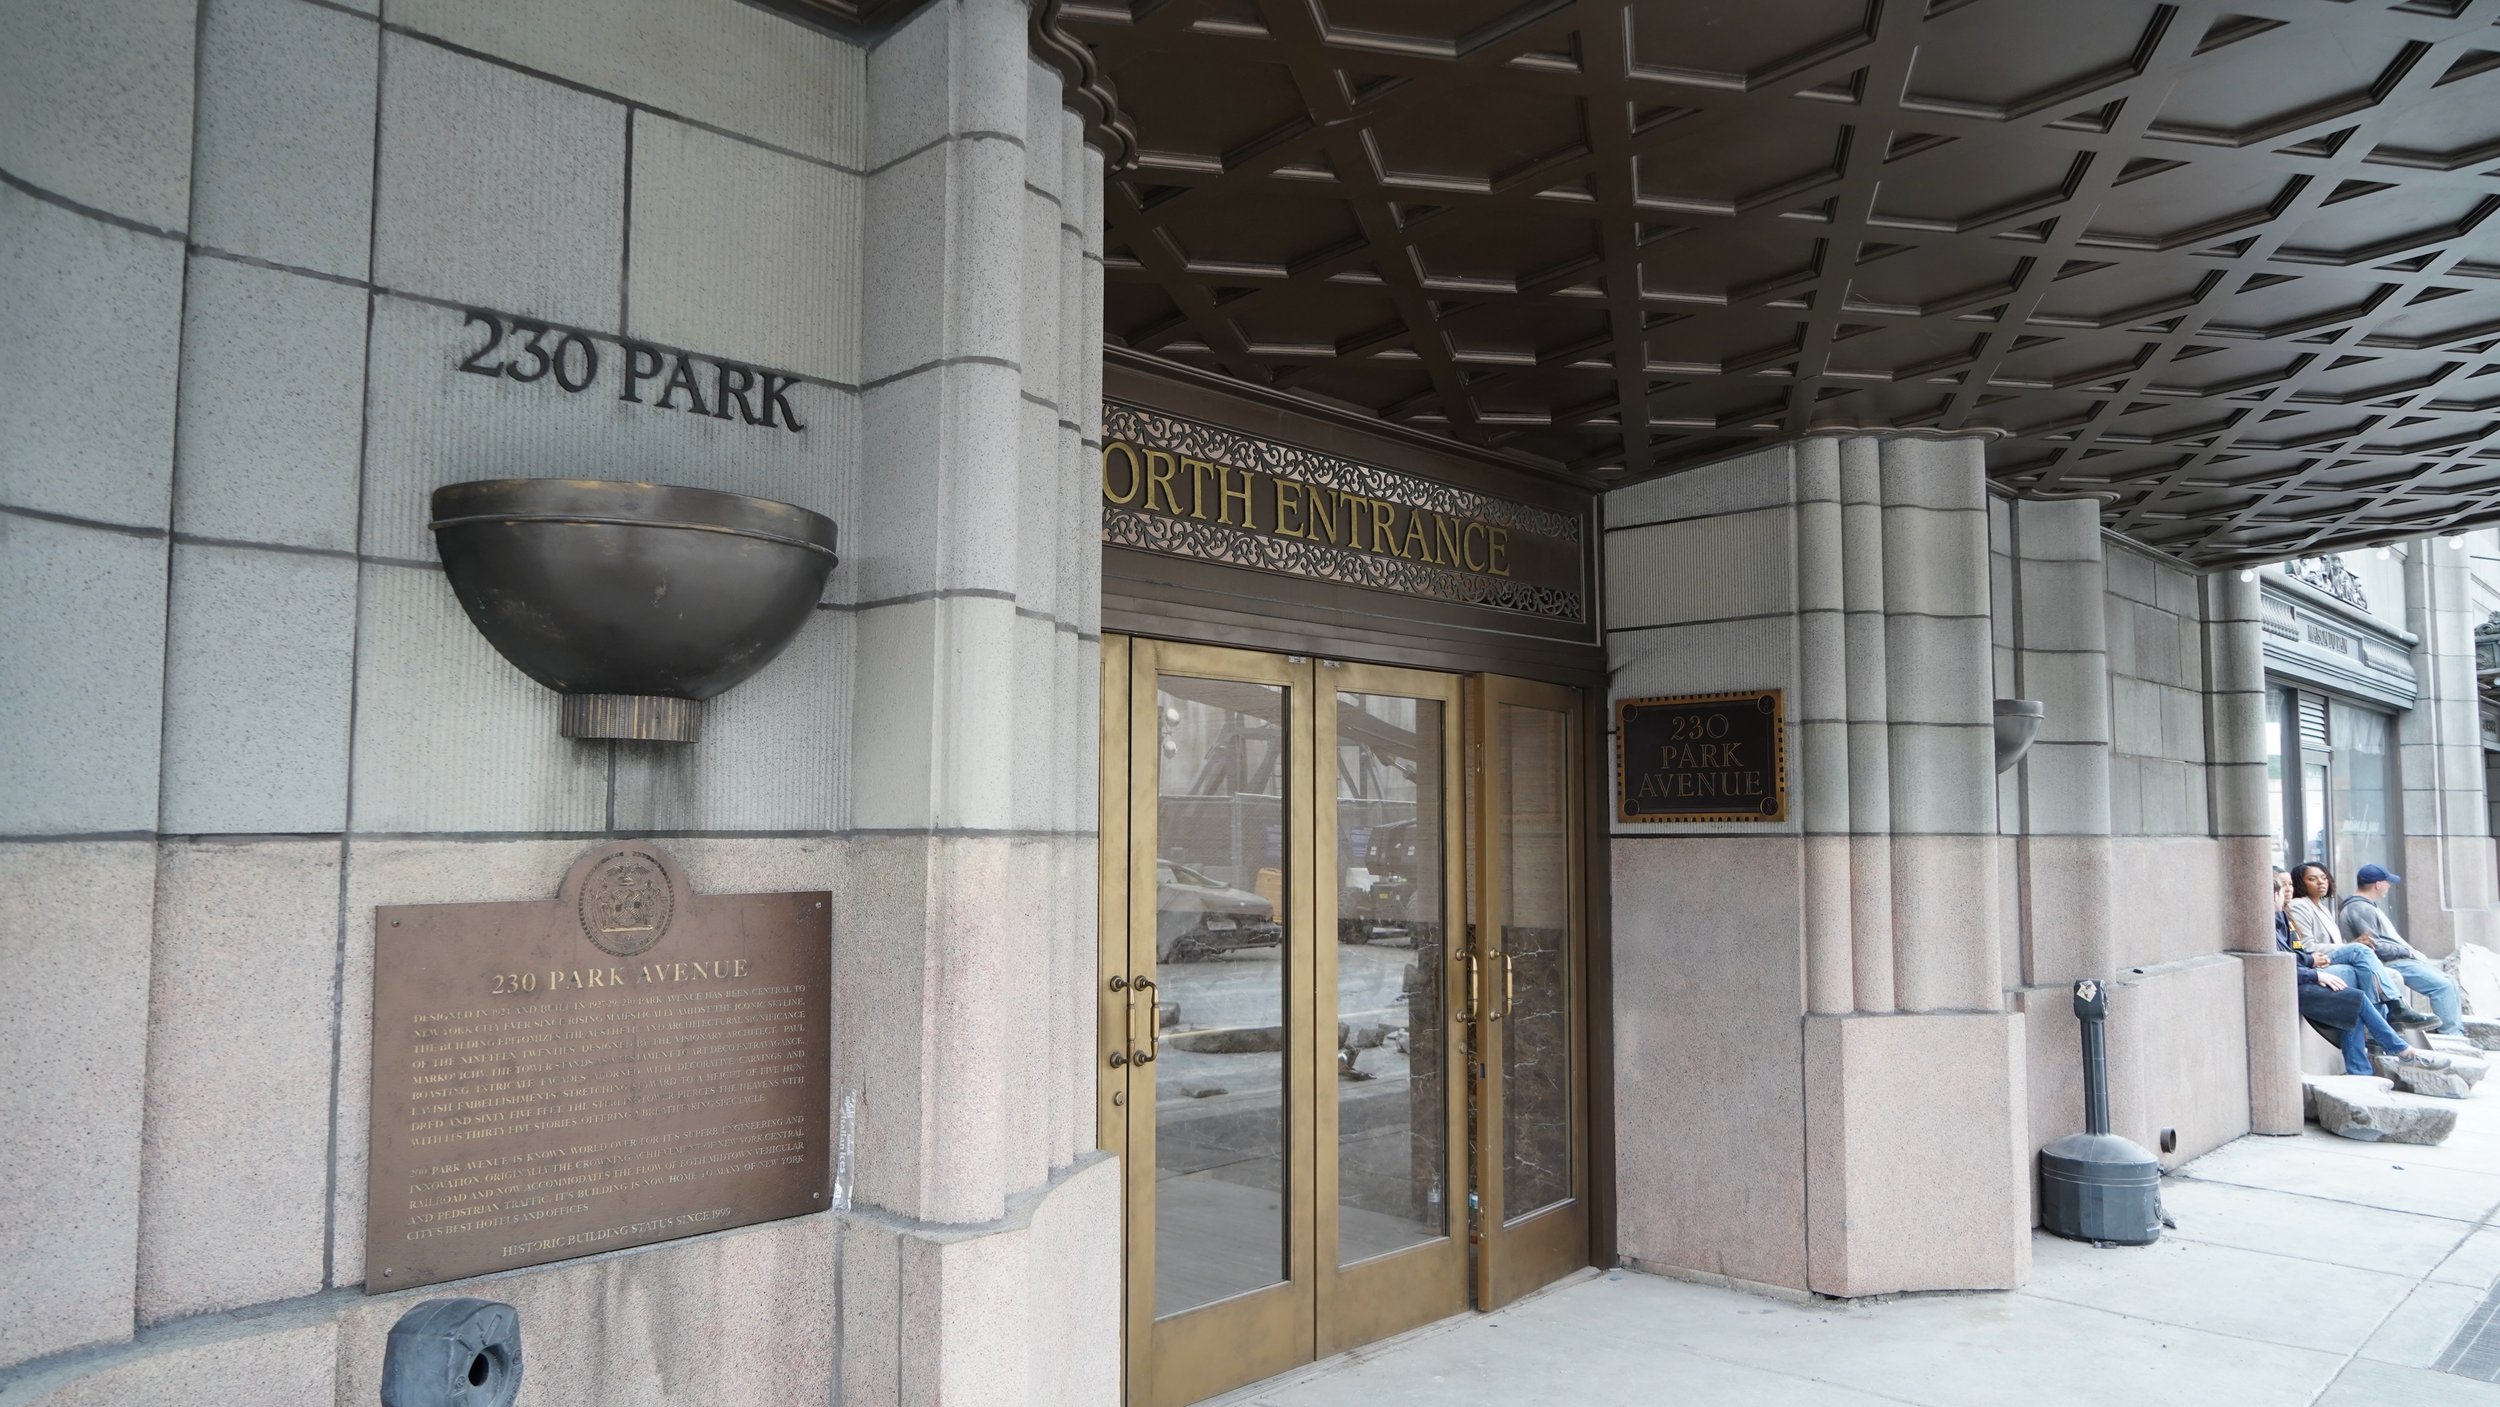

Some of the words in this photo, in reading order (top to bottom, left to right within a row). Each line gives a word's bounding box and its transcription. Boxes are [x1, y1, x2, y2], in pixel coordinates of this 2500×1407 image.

[459, 311, 598, 393] 230
[620, 342, 805, 433] PARK
[1275, 477, 1509, 576] ENTRANCE
[1670, 713, 1729, 741] 230
[1660, 742, 1744, 769] PARK
[1638, 771, 1763, 798] AVENUE
[492, 971, 536, 994] 230
[548, 966, 624, 990] PARK
[635, 958, 748, 984] AVENUE
[414, 1010, 472, 1022] DESIGNED
[475, 1009, 488, 1018] IN
[516, 1005, 537, 1014] AND
[574, 1001, 585, 1010] IN
[638, 995, 662, 1005] PARK
[667, 992, 702, 1003] AVENUE
[704, 990, 722, 1000] HAS
[725, 988, 748, 998] BEEN
[751, 985, 791, 996] CENTRAL
[794, 984, 805, 993] TO
[414, 1028, 438, 1038] NEW
[443, 1025, 472, 1036] YORK
[474, 1022, 499, 1033] CITY
[504, 1020, 530, 1030] EVER
[568, 1014, 602, 1025] RISING
[713, 1003, 731, 1012] THE
[734, 1000, 765, 1011] ICONIC
[412, 1059, 426, 1069] OF
[433, 1057, 453, 1067] THE
[460, 1051, 516, 1064] NINETEEN
[653, 1036, 671, 1046] THE
[675, 1031, 722, 1043] VISIONARY
[783, 1023, 805, 1033] PAUL
[414, 1043, 433, 1053] THE
[498, 1032, 560, 1046] EPITOMIZES
[565, 1030, 584, 1040] THE
[646, 1022, 665, 1032] AND
[667, 1016, 743, 1030] ARCHITECTURAL
[744, 1010, 805, 1023] SIGNIFICANCE
[412, 1085, 469, 1100] BOASTING
[475, 1078, 534, 1093] INTRICATE
[646, 1063, 671, 1074] WITH
[677, 1057, 734, 1071] DECORATIVE
[738, 1051, 782, 1064] CARVINGS
[786, 1049, 805, 1059] AND
[491, 1066, 512, 1076] THE
[516, 1062, 552, 1073] TOWER
[677, 1048, 688, 1057] TO
[692, 1046, 708, 1055] ART
[710, 1043, 734, 1054] DECO
[681, 1075, 693, 1084] TO
[706, 1070, 741, 1081] HEIGHT
[745, 1068, 757, 1077] OF
[760, 1065, 780, 1075] FIVE
[449, 1115, 471, 1126] AND
[474, 1111, 504, 1123] SIXTY
[509, 1108, 532, 1119] FIVE
[568, 1101, 587, 1112] THE
[677, 1086, 715, 1098] PIERCES
[719, 1083, 736, 1093] THE
[739, 1078, 779, 1091] HEAVENS
[781, 1075, 804, 1086] WITH
[411, 1134, 441, 1146] WITH
[466, 1126, 504, 1139] THIRTY
[508, 1122, 530, 1134] FIVE
[580, 1110, 631, 1124] OFFERING
[431, 1161, 460, 1175] PARK
[466, 1155, 509, 1170] AVENUE
[512, 1153, 522, 1163] IS
[526, 1147, 566, 1161] KNOWN
[570, 1141, 607, 1155] WORLD
[610, 1137, 636, 1150] OVER
[682, 1126, 718, 1140] SUPERB
[721, 1118, 782, 1134] ENGINEERING
[785, 1115, 804, 1125] AND
[471, 1187, 493, 1200] AND
[496, 1183, 520, 1196] NOW
[523, 1170, 610, 1192] ACCOMMODATES
[613, 1166, 634, 1178] THE
[635, 1162, 661, 1174] FLOW
[664, 1160, 676, 1170] OF
[680, 1156, 705, 1168] BOTH
[708, 1149, 751, 1163] MIDTOWN
[755, 1141, 804, 1156] VEHICULAR
[552, 1161, 574, 1172] THE
[575, 1152, 630, 1169] CROWNING
[703, 1140, 714, 1150] OF
[717, 1137, 736, 1148] NEW
[739, 1133, 763, 1145] YORK
[764, 1128, 804, 1141] CENTRAL
[408, 1212, 433, 1225] AND
[576, 1182, 627, 1198] BUILDING
[630, 1180, 639, 1190] IS
[642, 1176, 664, 1188] NOW
[668, 1171, 696, 1184] HOME
[701, 1168, 712, 1178] TO
[716, 1164, 739, 1176] MANY
[744, 1161, 755, 1172] OF
[758, 1158, 777, 1169] NEW
[781, 1154, 804, 1166] YORK
[445, 1221, 472, 1234] BEST
[476, 1213, 518, 1229] HOTELS
[522, 1209, 544, 1222] AND
[502, 1236, 565, 1257] HISTORIC
[567, 1224, 628, 1245] BUILDING
[630, 1216, 673, 1234] STATUS
[675, 1210, 709, 1226] SINCE
[711, 1206, 731, 1220] 1999
